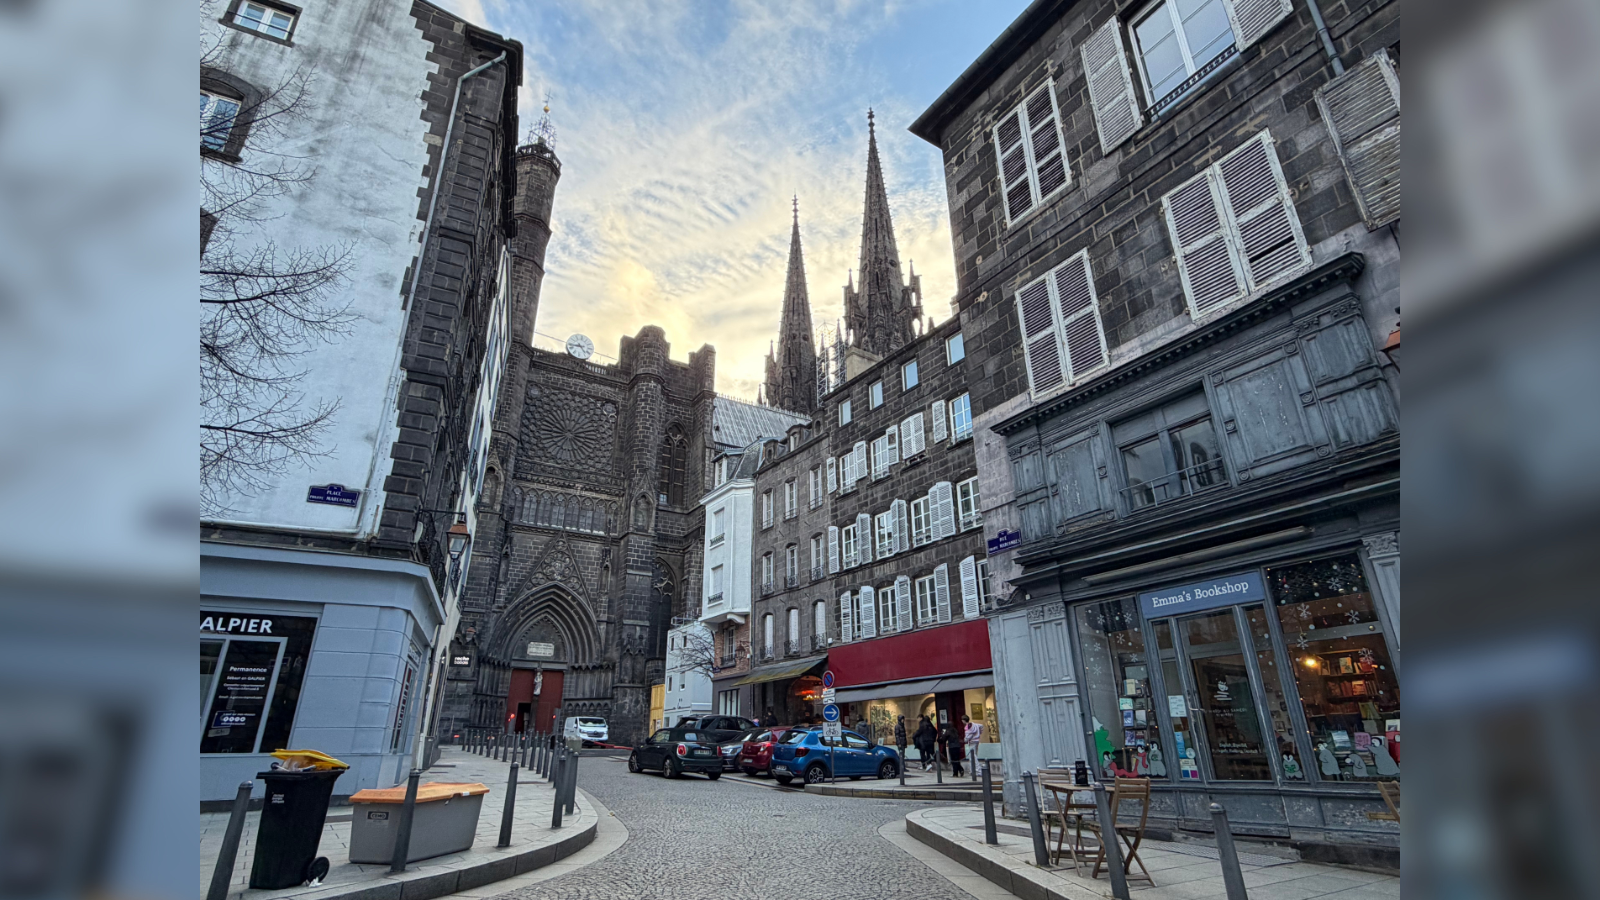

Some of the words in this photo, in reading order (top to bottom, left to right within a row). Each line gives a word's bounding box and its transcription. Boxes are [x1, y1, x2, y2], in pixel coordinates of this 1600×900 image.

[1151, 590, 1192, 608] Emma's
[1193, 581, 1249, 600] Bookshop
[200, 616, 273, 634] ALPIER
